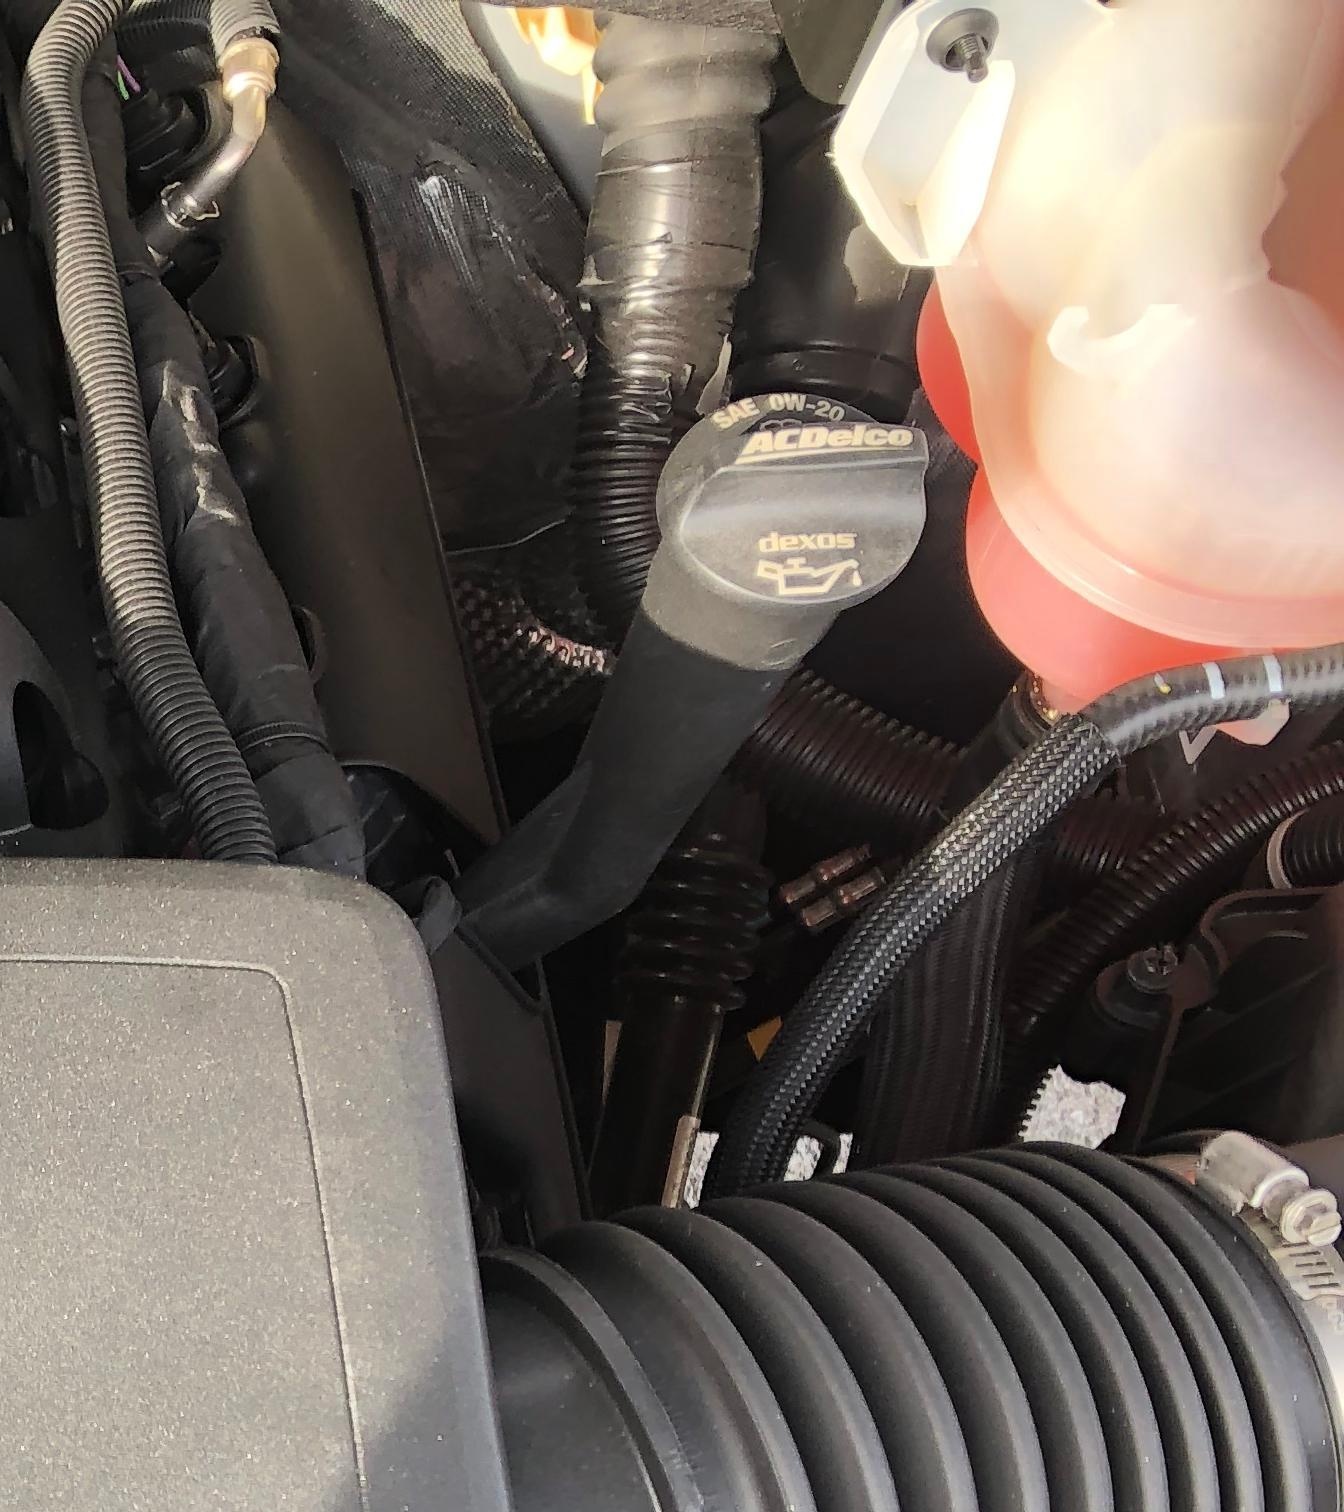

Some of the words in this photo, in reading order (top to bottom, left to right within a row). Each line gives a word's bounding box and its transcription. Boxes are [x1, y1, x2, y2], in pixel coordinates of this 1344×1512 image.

[711, 397, 760, 430] SAE
[769, 393, 845, 422] 0W-20
[741, 425, 914, 454] ACDelco
[758, 531, 857, 552] dexos
